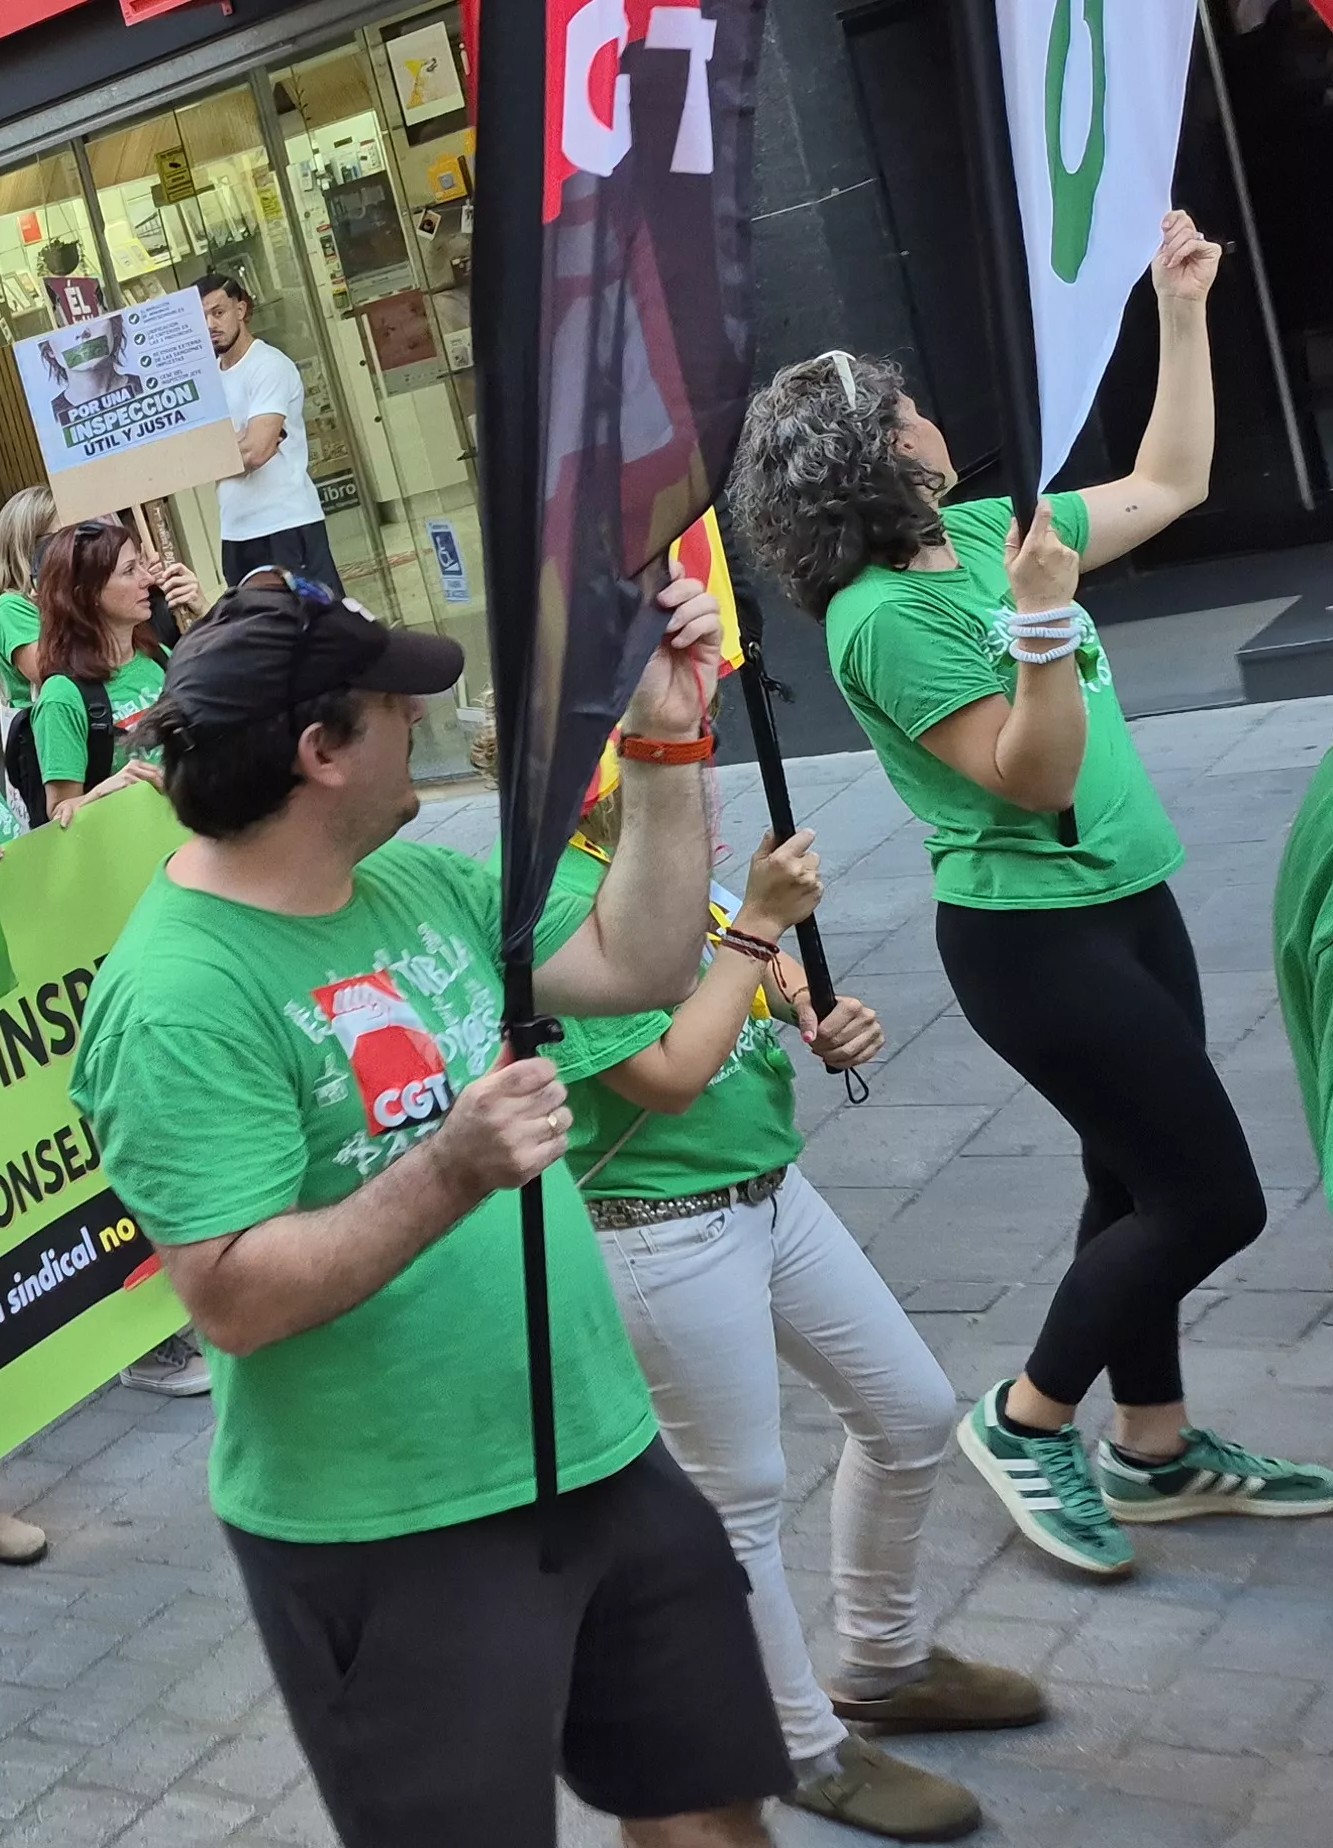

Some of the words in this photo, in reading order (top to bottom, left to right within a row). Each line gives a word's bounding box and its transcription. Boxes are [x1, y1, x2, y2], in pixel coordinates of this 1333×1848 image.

[68, 402, 99, 422] POR
[102, 389, 131, 409] UNA
[70, 383, 193, 445] INSPECCIÓN
[122, 430, 135, 442] Y
[136, 410, 187, 438] JUSTA
[373, 1071, 450, 1128] CGT
[7, 1225, 99, 1316] sindical
[98, 1217, 137, 1253] no
